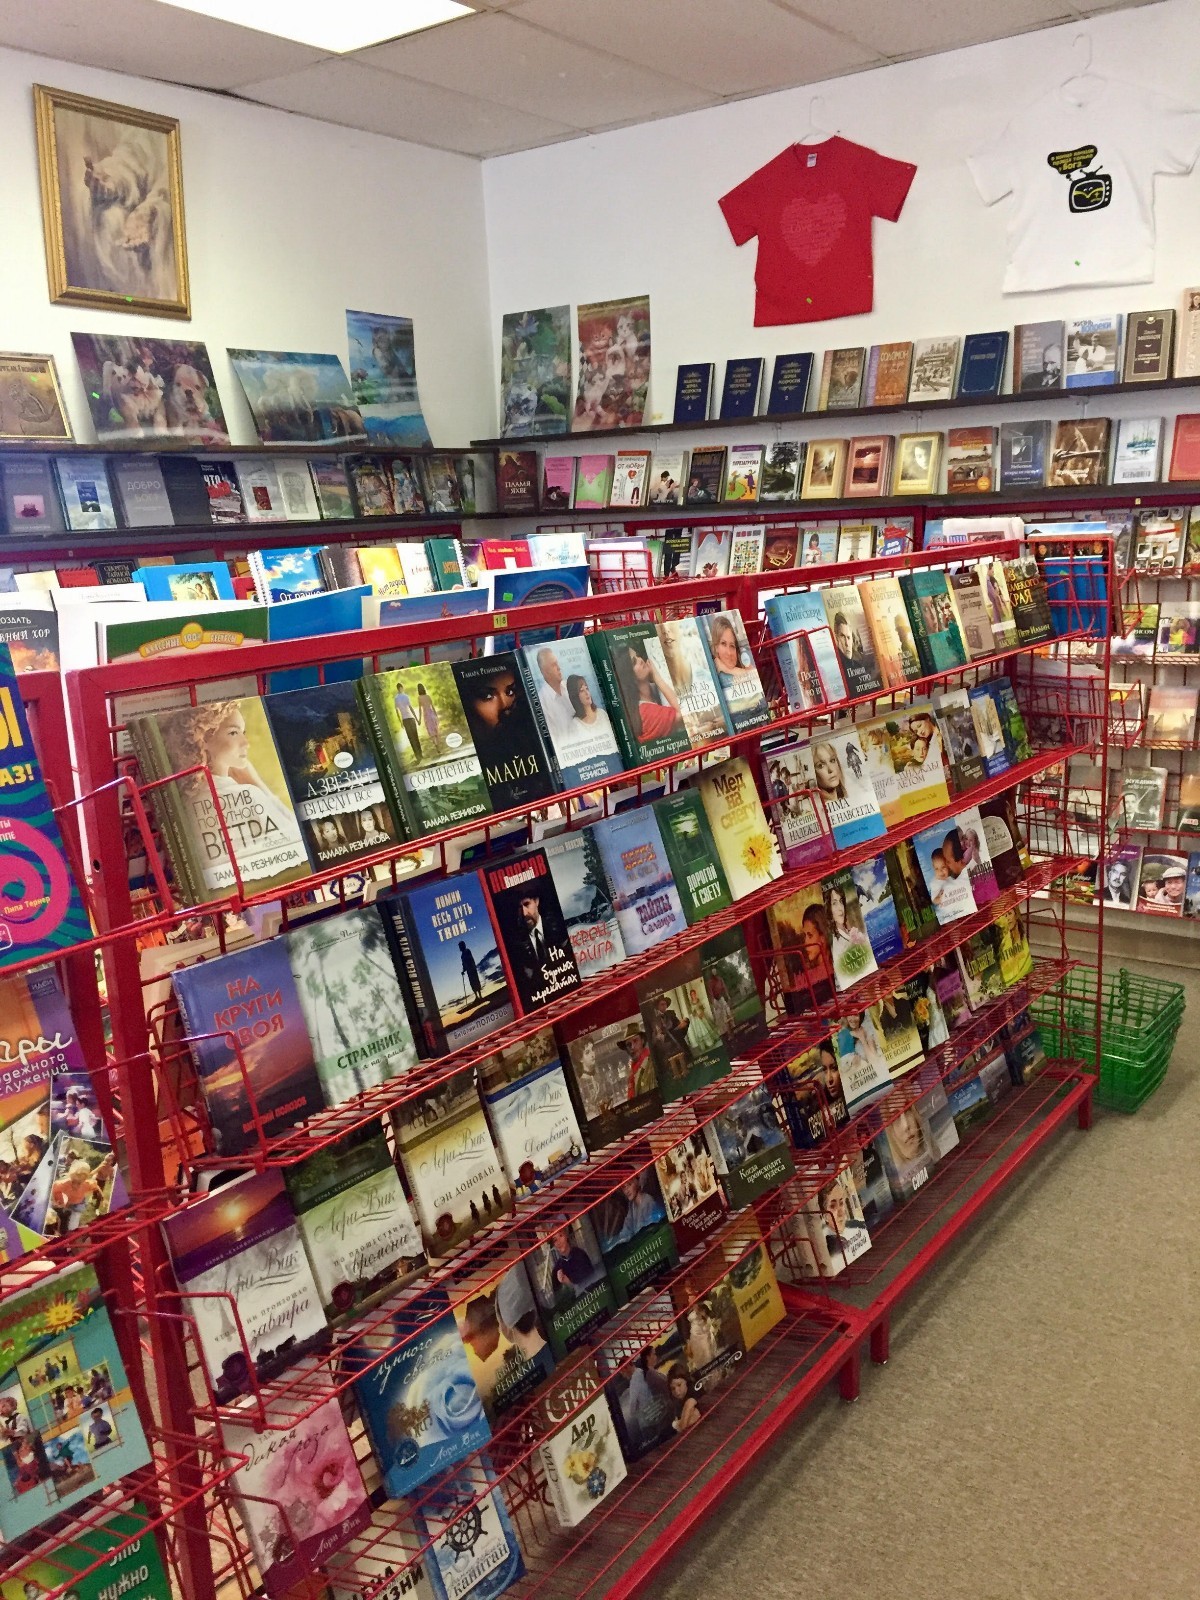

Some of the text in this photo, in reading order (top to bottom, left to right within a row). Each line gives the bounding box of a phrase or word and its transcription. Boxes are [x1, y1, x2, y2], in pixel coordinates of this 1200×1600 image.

[127, 481, 162, 491] ДОБРО
[510, 487, 527, 495] ЯХВЕ
[0, 616, 31, 625] ОЗДАТЬ
[639, 744, 666, 762] Пустая
[409, 759, 475, 789] СОЧИНЕНИЕ
[486, 754, 540, 787] МАЙЯ
[307, 781, 317, 798] А
[711, 773, 746, 798] Мед
[724, 791, 743, 809] на
[192, 789, 253, 818] ПРОТИВ
[422, 803, 487, 829] ТАМАРА РЕЗНИКОВА
[720, 801, 758, 830] снегу
[826, 798, 850, 814] ИМА
[201, 815, 281, 861] ВЕТРА
[318, 833, 391, 862] ТАМАРА РЕЗНИКОВА
[214, 849, 300, 882] ТАМРА РЕЗНИКОВА
[504, 867, 536, 889] Виталий
[686, 862, 718, 892] ДОРОГОЙ
[434, 889, 462, 909] ПОМНИ
[635, 893, 673, 924] ТАЙНЫ
[698, 883, 722, 907] СВЕТУ
[431, 902, 473, 928] ВЕСЬ ПУТЬ
[549, 945, 566, 963] На
[226, 974, 262, 1001] НА
[531, 973, 578, 1003] перекатах
[540, 960, 575, 987] бурных
[213, 987, 284, 1030] КРУГИ
[476, 1008, 509, 1031] ПОЛОЗОВ
[224, 1013, 285, 1050] СВОЯ
[336, 1030, 404, 1071] СТРАННИК
[0, 1053, 66, 1087] дежного
[433, 1165, 496, 1208] СЭН ДОНОВАН
[763, 1163, 786, 1181] чудеса
[361, 1187, 397, 1213] Вик
[259, 1247, 299, 1276] Вик
[351, 1233, 409, 1280] времени
[619, 1235, 665, 1273] ОБЕЩАНИЕ
[628, 1252, 662, 1281] РЕБЕККИ
[553, 1282, 607, 1332] ВОЗВРАЩЕНИЕ
[566, 1300, 601, 1333] РЕБЕККИ
[739, 1299, 754, 1313] ТРИ
[251, 1296, 312, 1347] завтра
[372, 1337, 434, 1396] лунного
[494, 1358, 537, 1397] РЕБЕККИ
[570, 1412, 598, 1451] Дар
[98, 1564, 150, 1600] нужно
[452, 1542, 511, 1599] капитан
